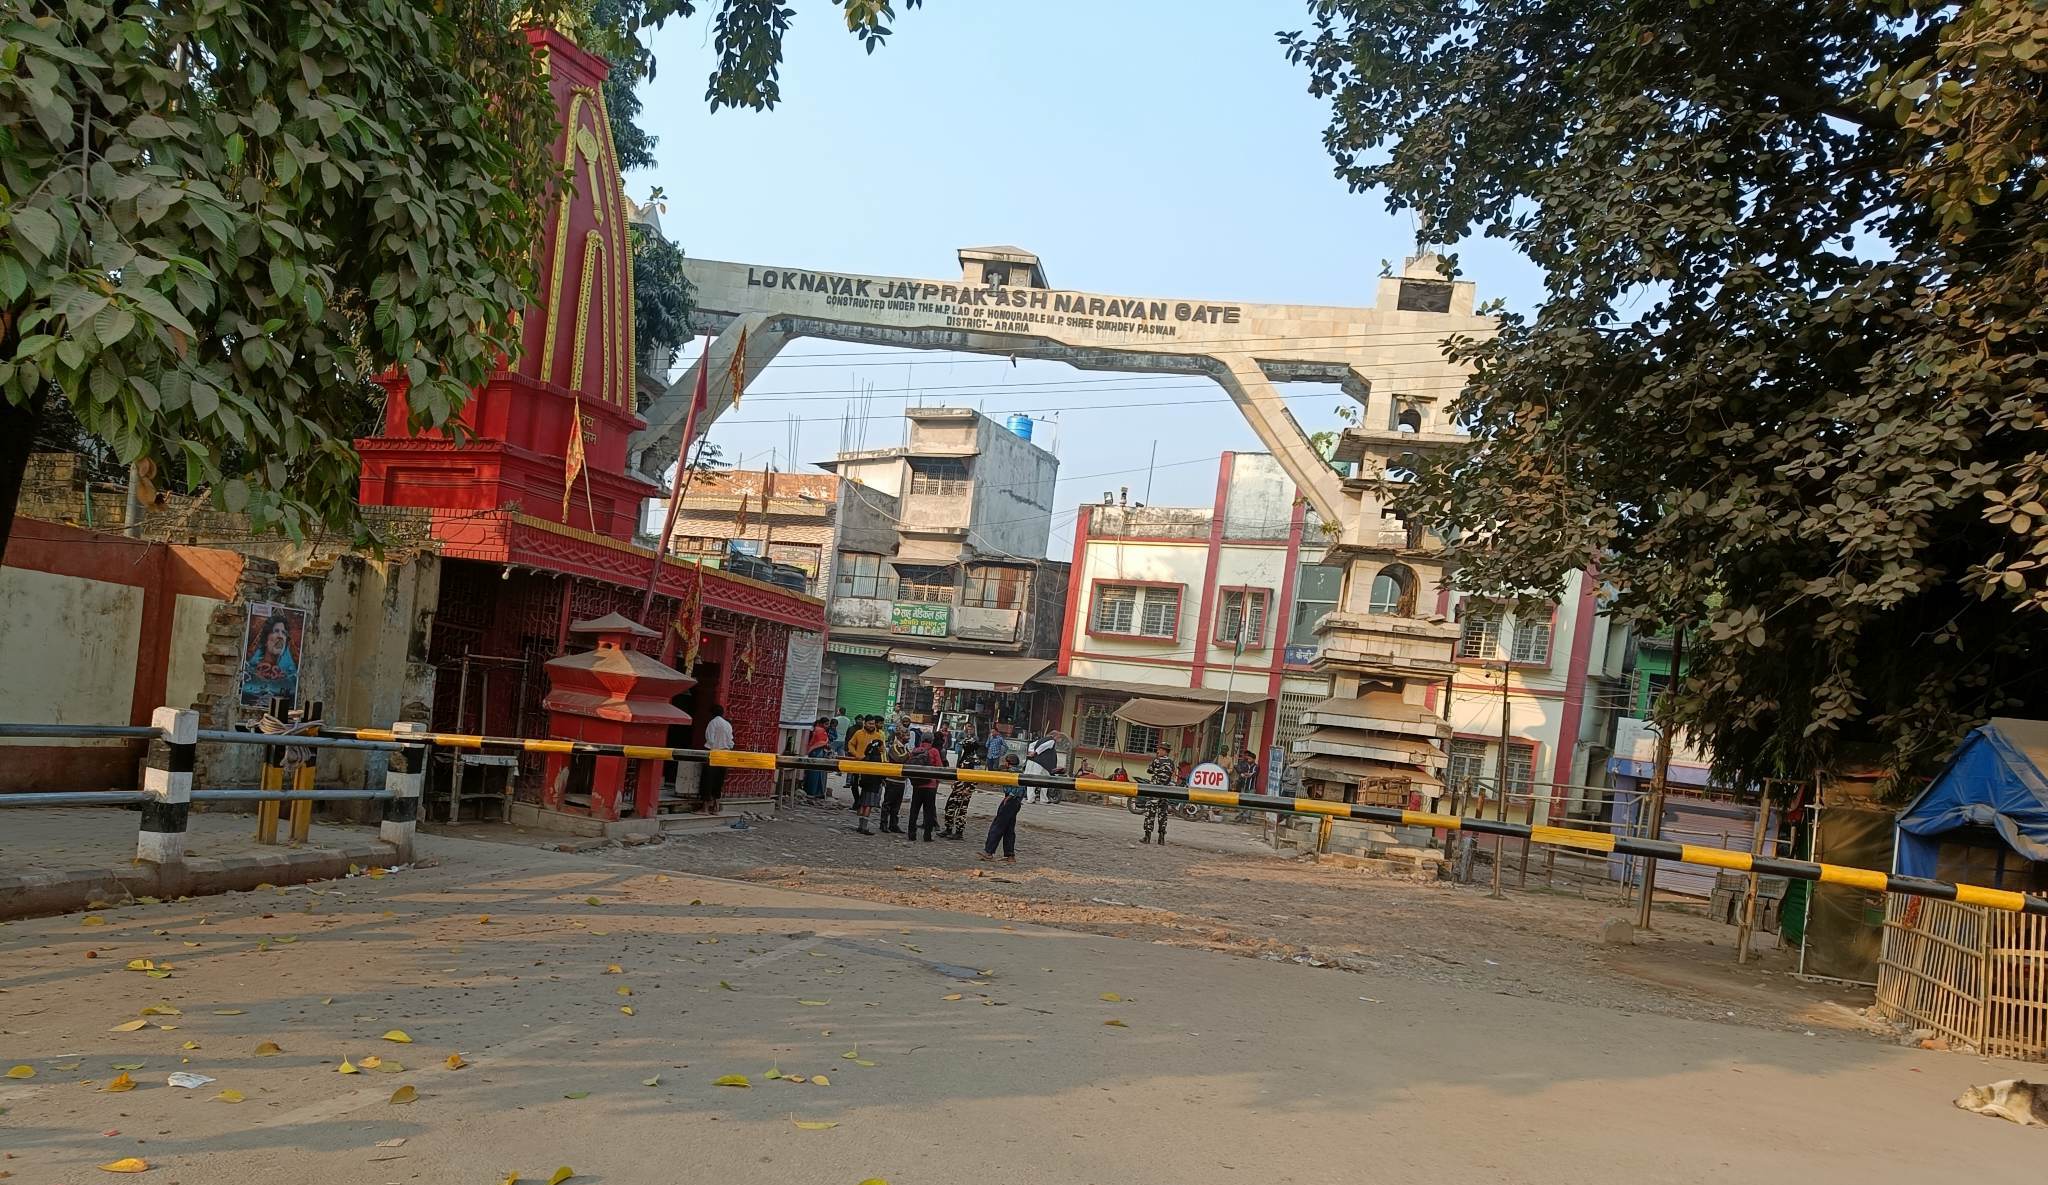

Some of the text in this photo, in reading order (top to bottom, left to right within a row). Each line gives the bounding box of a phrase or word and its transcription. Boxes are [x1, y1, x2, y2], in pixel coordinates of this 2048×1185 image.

[747, 267, 1241, 324] LOKNAYAK JAYPRAKASH NARAYAN GATE
[826, 295, 886, 310] CONSTRUCTED
[887, 300, 916, 312] UNDER
[918, 302, 934, 313] THE
[952, 305, 971, 316] LAD
[973, 307, 985, 317] OF
[987, 307, 1046, 324] HONOURABLE
[1066, 317, 1094, 329] SHREE
[1096, 321, 1135, 333] SUKHDEV
[1136, 324, 1176, 336] PASWAN
[994, 319, 1030, 333] ARARIA
[1194, 771, 1224, 786] STOP
